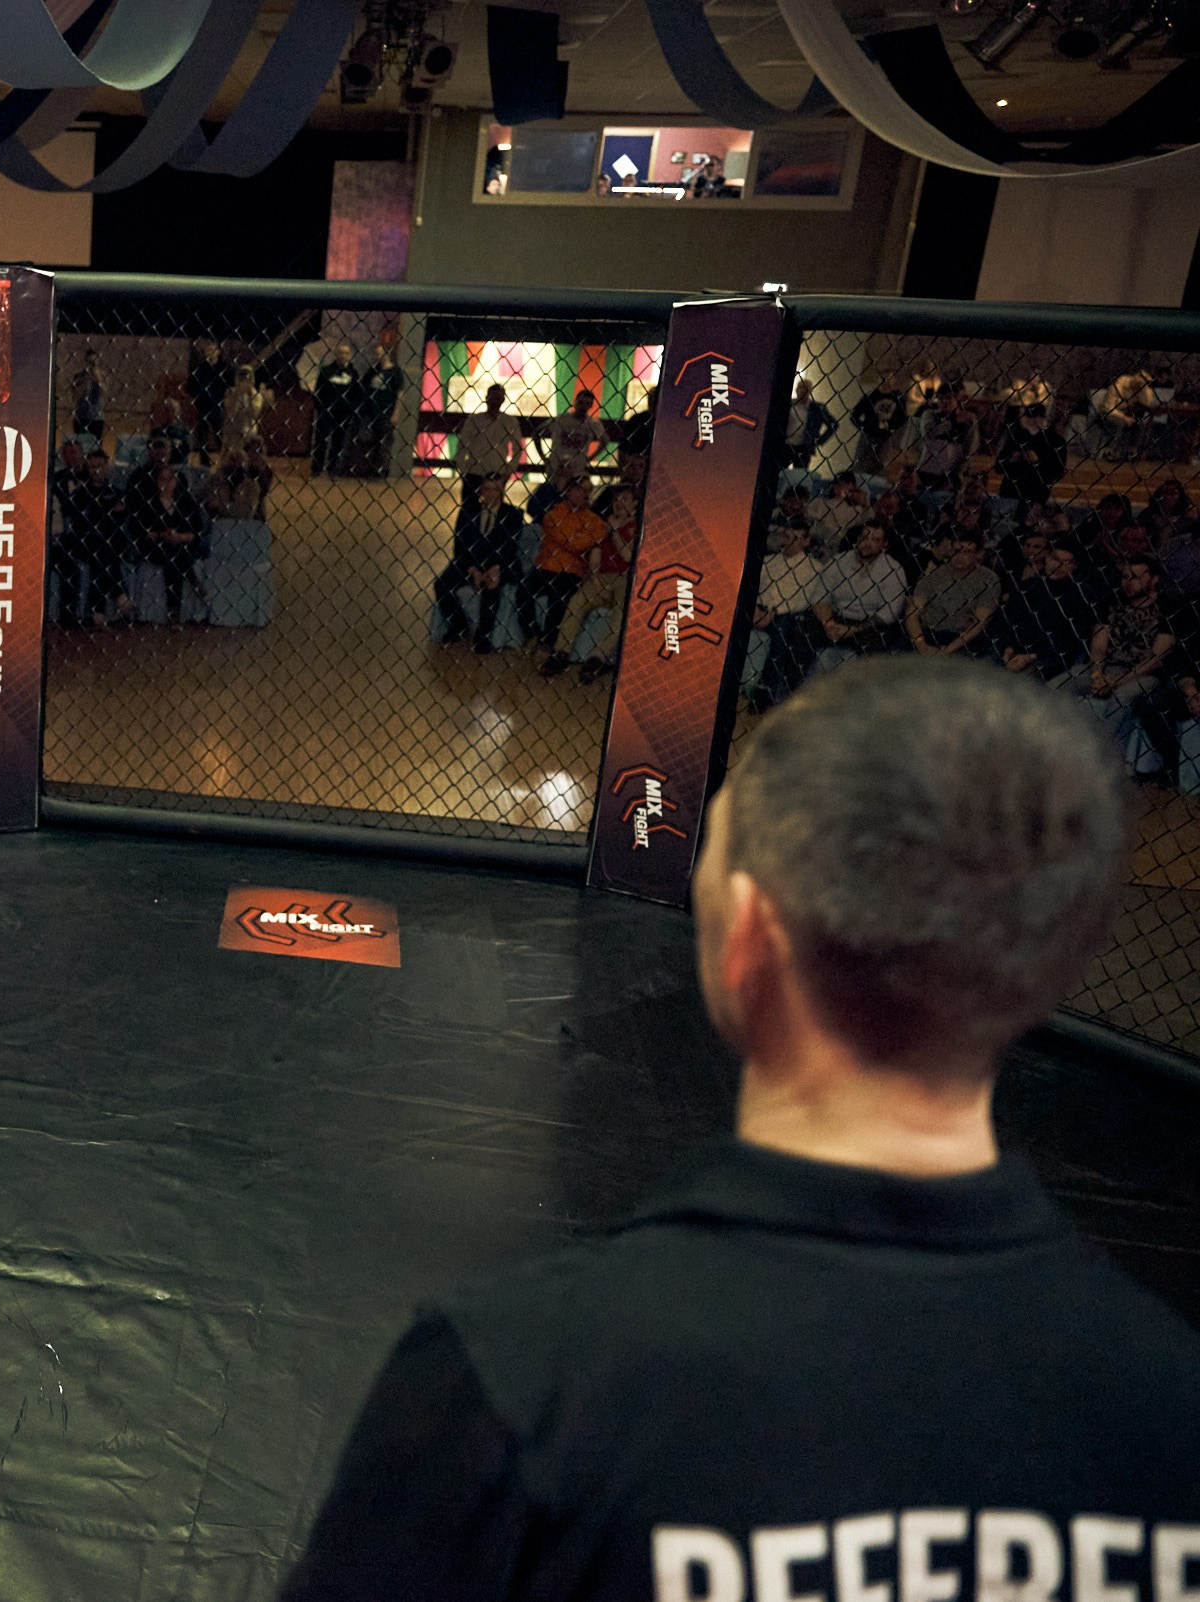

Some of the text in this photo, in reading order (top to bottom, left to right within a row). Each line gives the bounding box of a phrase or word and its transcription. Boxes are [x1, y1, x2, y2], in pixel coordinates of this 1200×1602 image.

[710, 363, 730, 406] MIX
[700, 397, 715, 444] FIGHT
[676, 579, 695, 621] MIX
[665, 611, 680, 654] FIGHT
[644, 778, 663, 818] MIX
[634, 806, 649, 848] FIGHT
[260, 912, 319, 924] MIX
[309, 923, 374, 934] FIGHT
